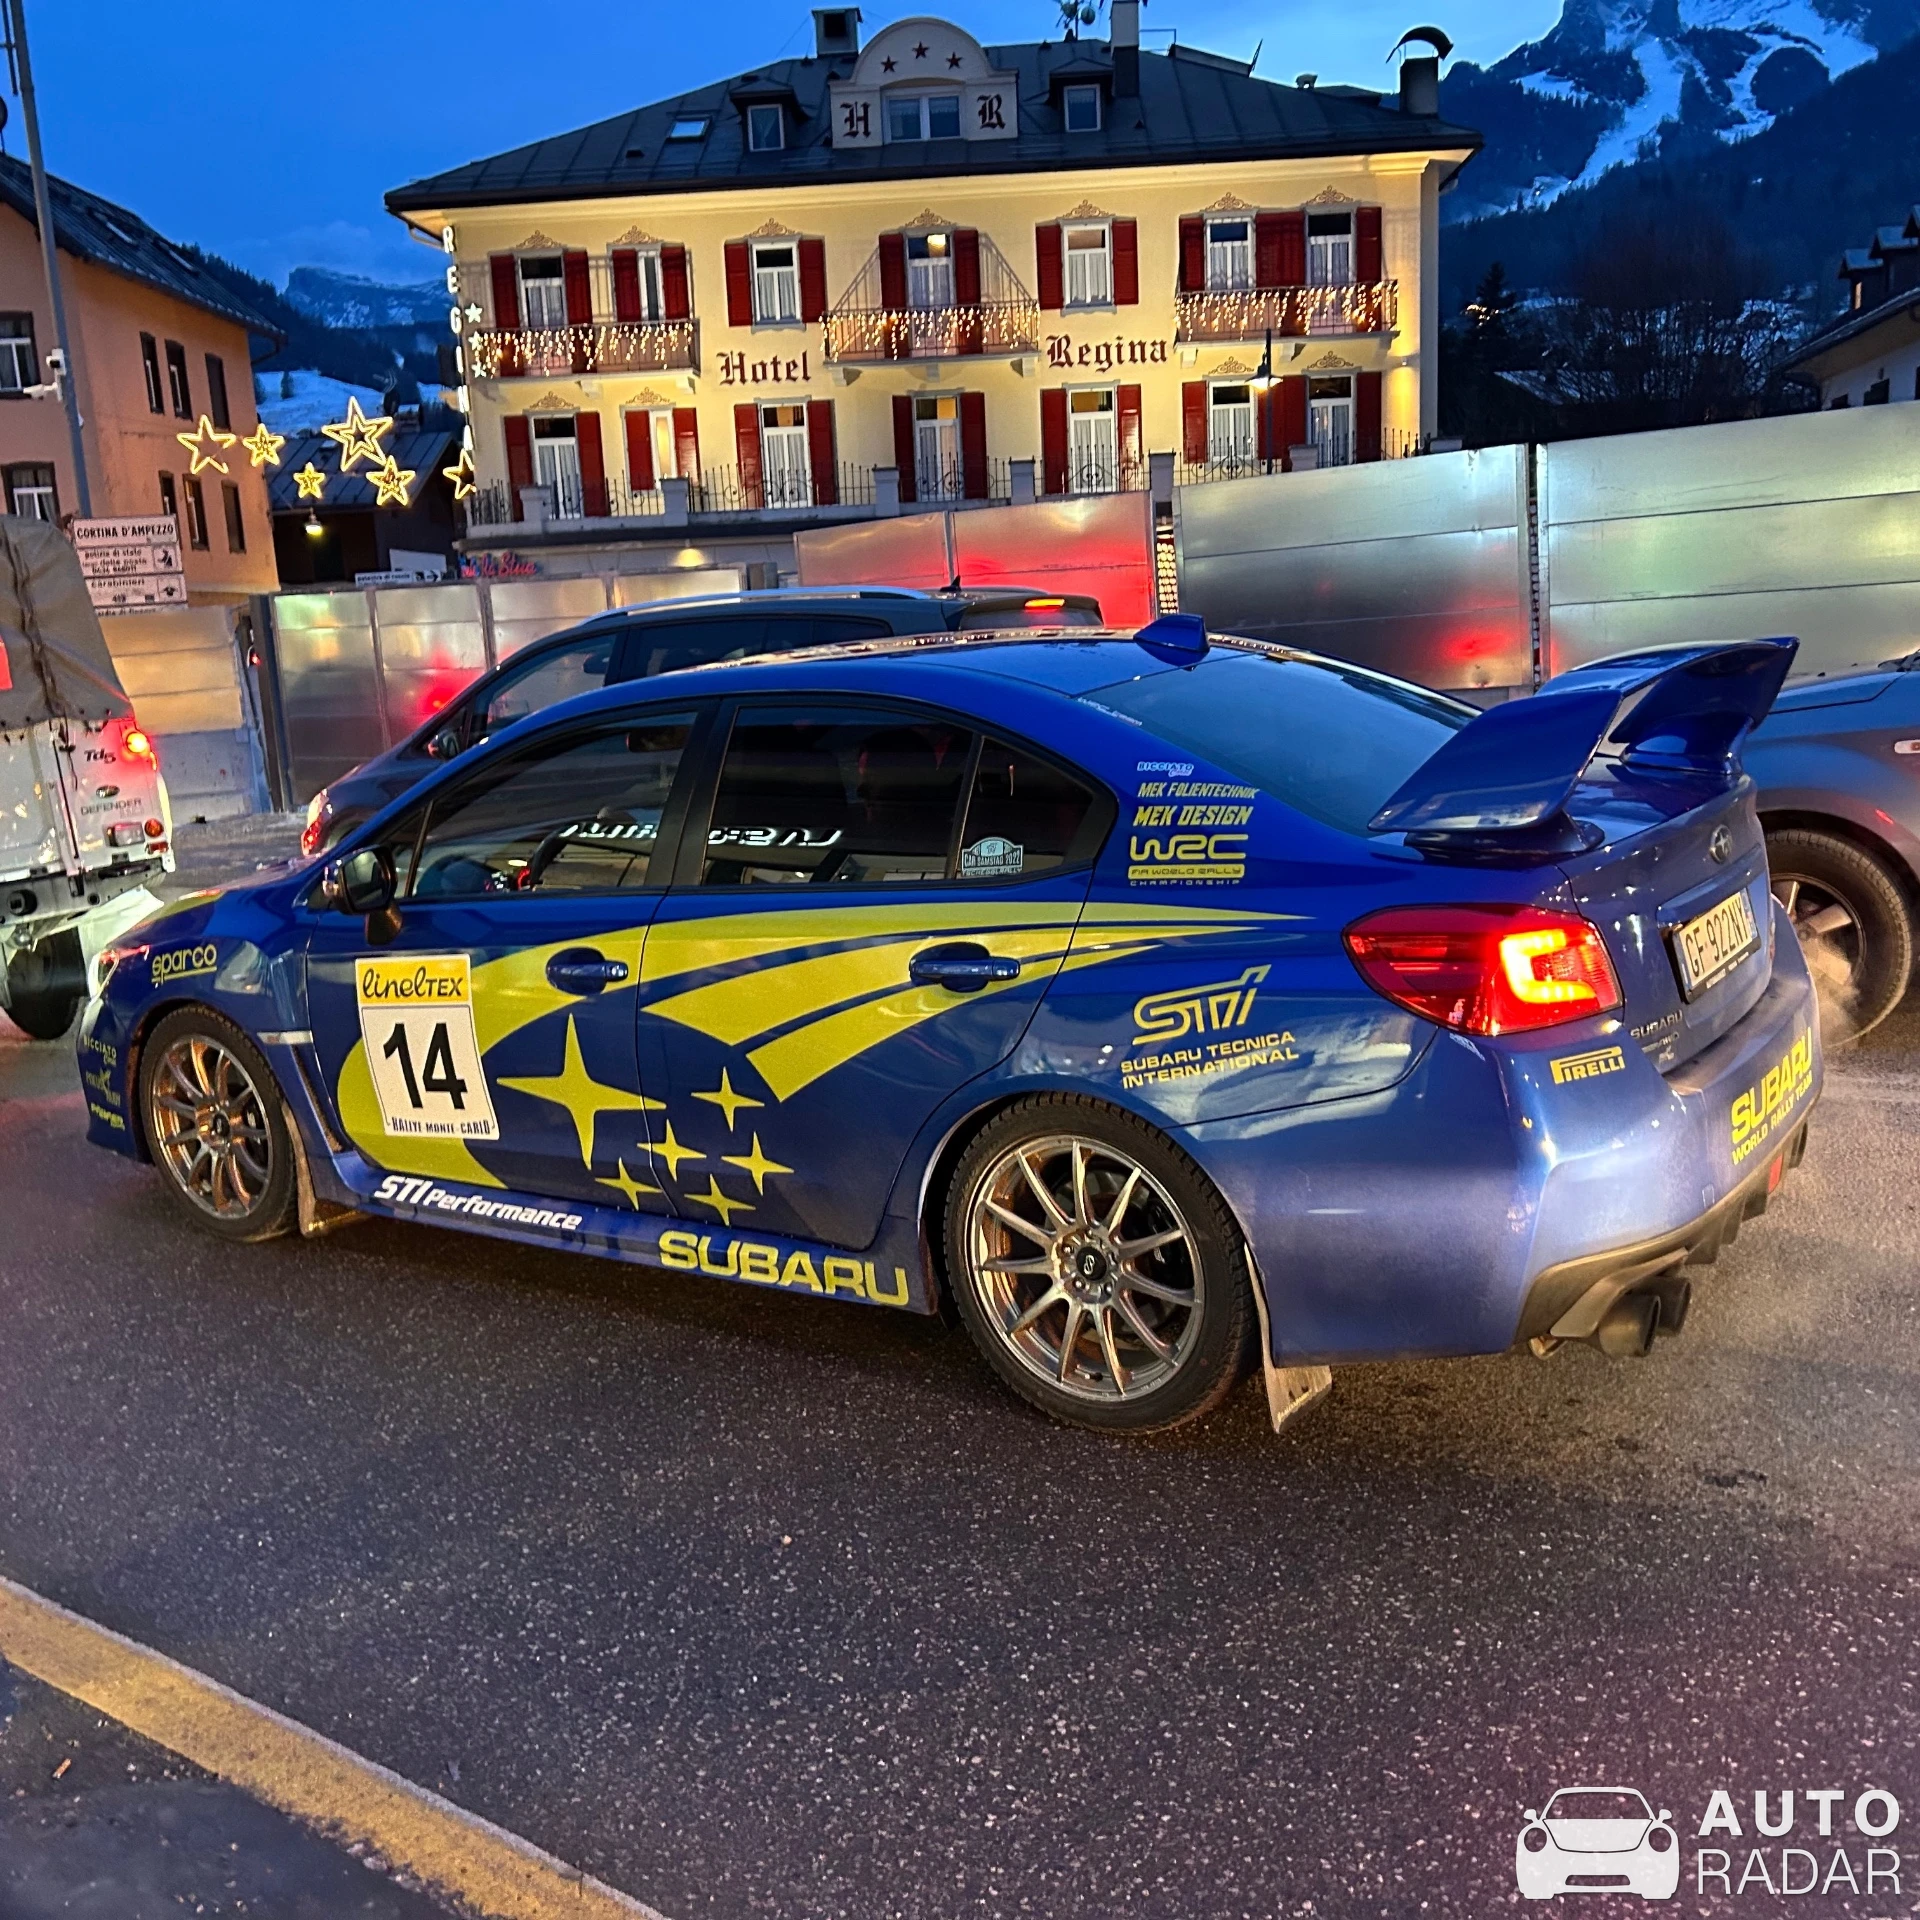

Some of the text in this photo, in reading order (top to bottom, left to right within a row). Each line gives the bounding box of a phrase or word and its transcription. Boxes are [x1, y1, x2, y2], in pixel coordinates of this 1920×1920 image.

[716, 334, 1168, 386] Hotel Regina
[77, 524, 174, 539] CORTINA D'AMPEZZO
[81, 797, 142, 816] DEFENDER
[1137, 782, 1260, 799] MEK FOLIENTECHNIK
[1132, 805, 1254, 827] MEK DESIGN
[1129, 833, 1249, 862] WRC
[152, 944, 217, 984] sparco
[1630, 1009, 1683, 1040] SUBARU
[382, 1022, 468, 1111] 14
[1120, 1030, 1296, 1074] SUBARU TECNICA
[1121, 1047, 1300, 1090] INTERNATIONAL
[1549, 1046, 1626, 1085] PIRELLI
[1731, 1026, 1812, 1145] SUBARU
[1732, 1070, 1813, 1166] WORLD RALLY TEAM
[658, 1229, 909, 1306] SUBARU
